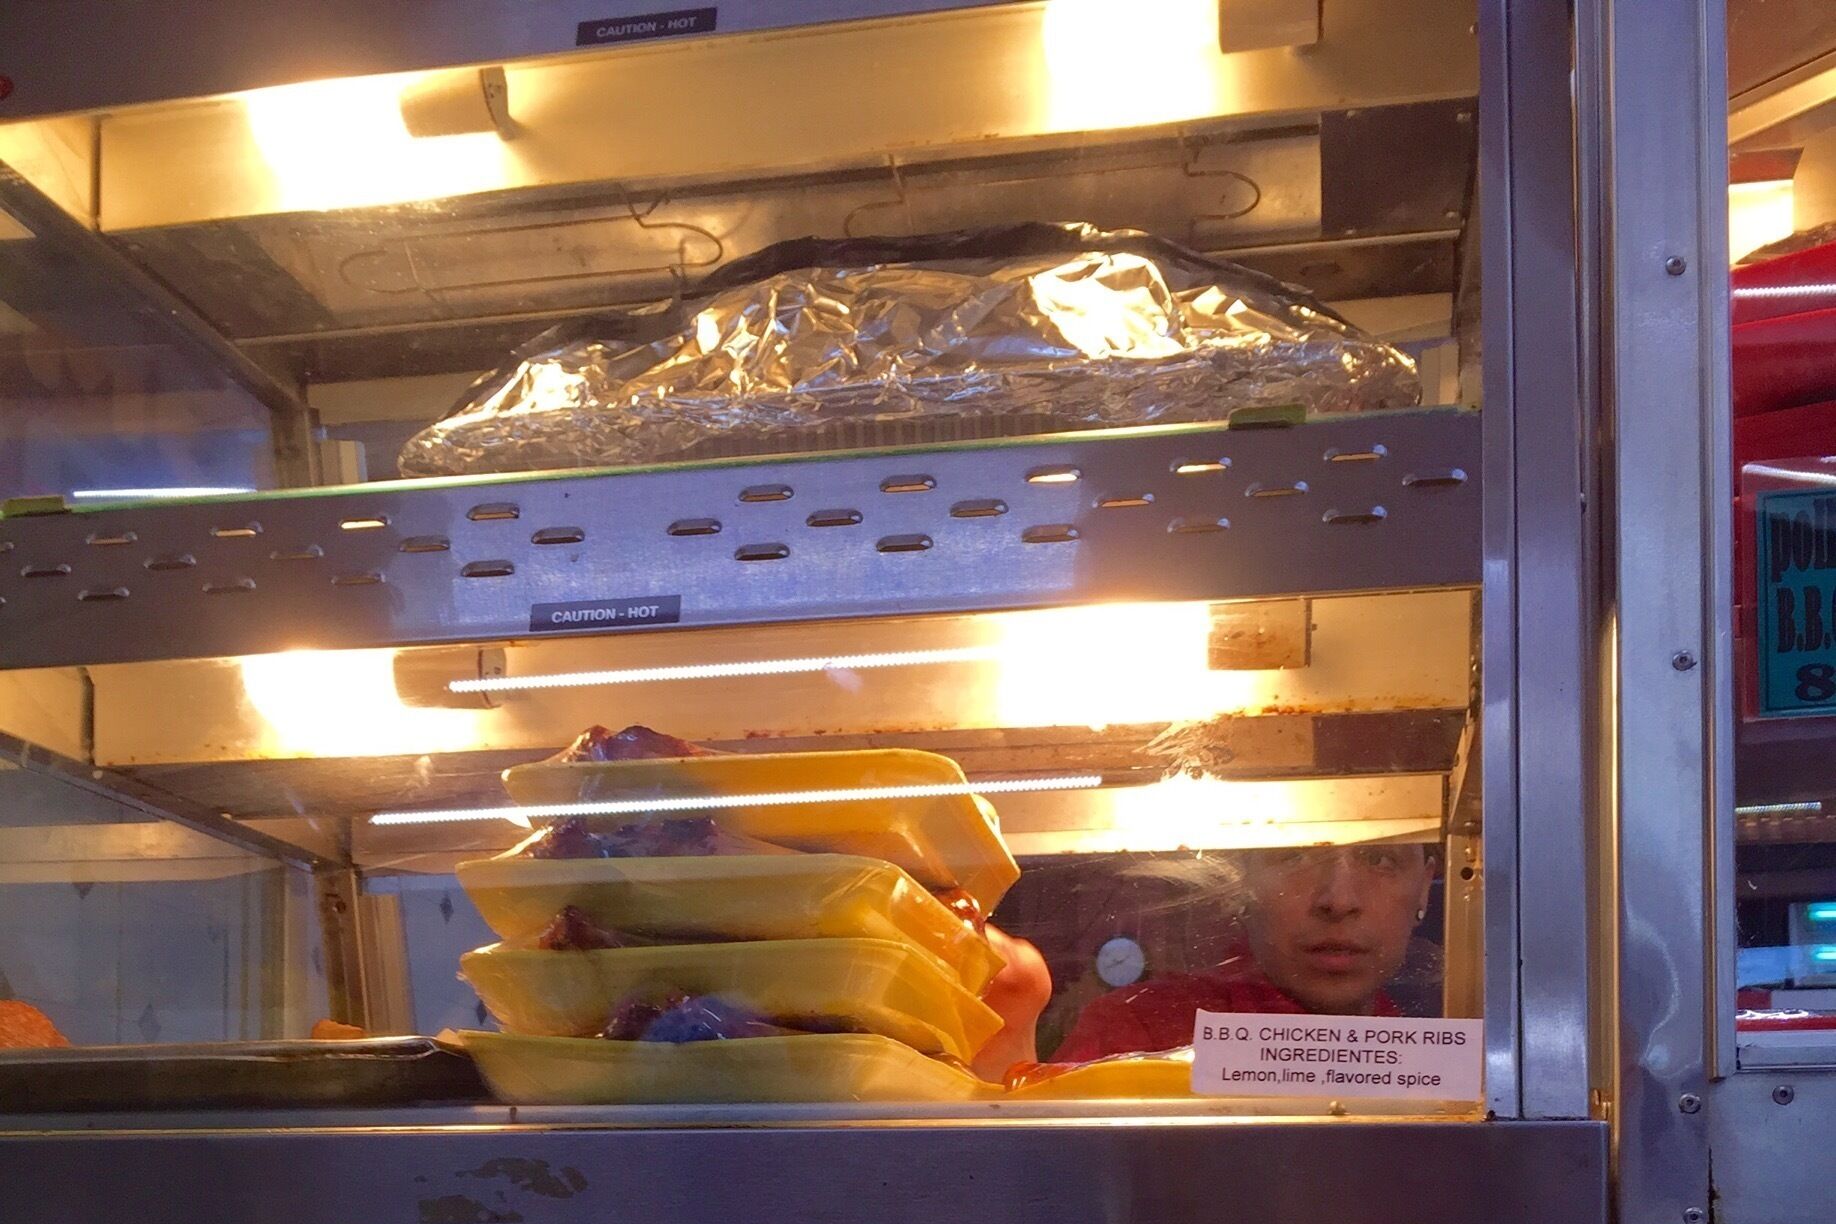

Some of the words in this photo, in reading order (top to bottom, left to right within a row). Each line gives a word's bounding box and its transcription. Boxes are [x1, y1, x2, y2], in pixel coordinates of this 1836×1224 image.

[596, 22, 657, 37] CAUTION
[668, 16, 697, 29] HOT
[552, 608, 617, 623] CAUTION
[628, 605, 659, 619] HOT
[1777, 586, 1836, 653] B.B.
[1203, 1026, 1253, 1041] B.B.Q.
[1259, 1027, 1341, 1042] CHICKEN
[1346, 1029, 1358, 1043] &
[1364, 1029, 1417, 1045] PORK
[1423, 1031, 1466, 1046] RIBS
[1260, 1047, 1402, 1065] INGREDIENTES:
[1397, 1072, 1441, 1089] spice
